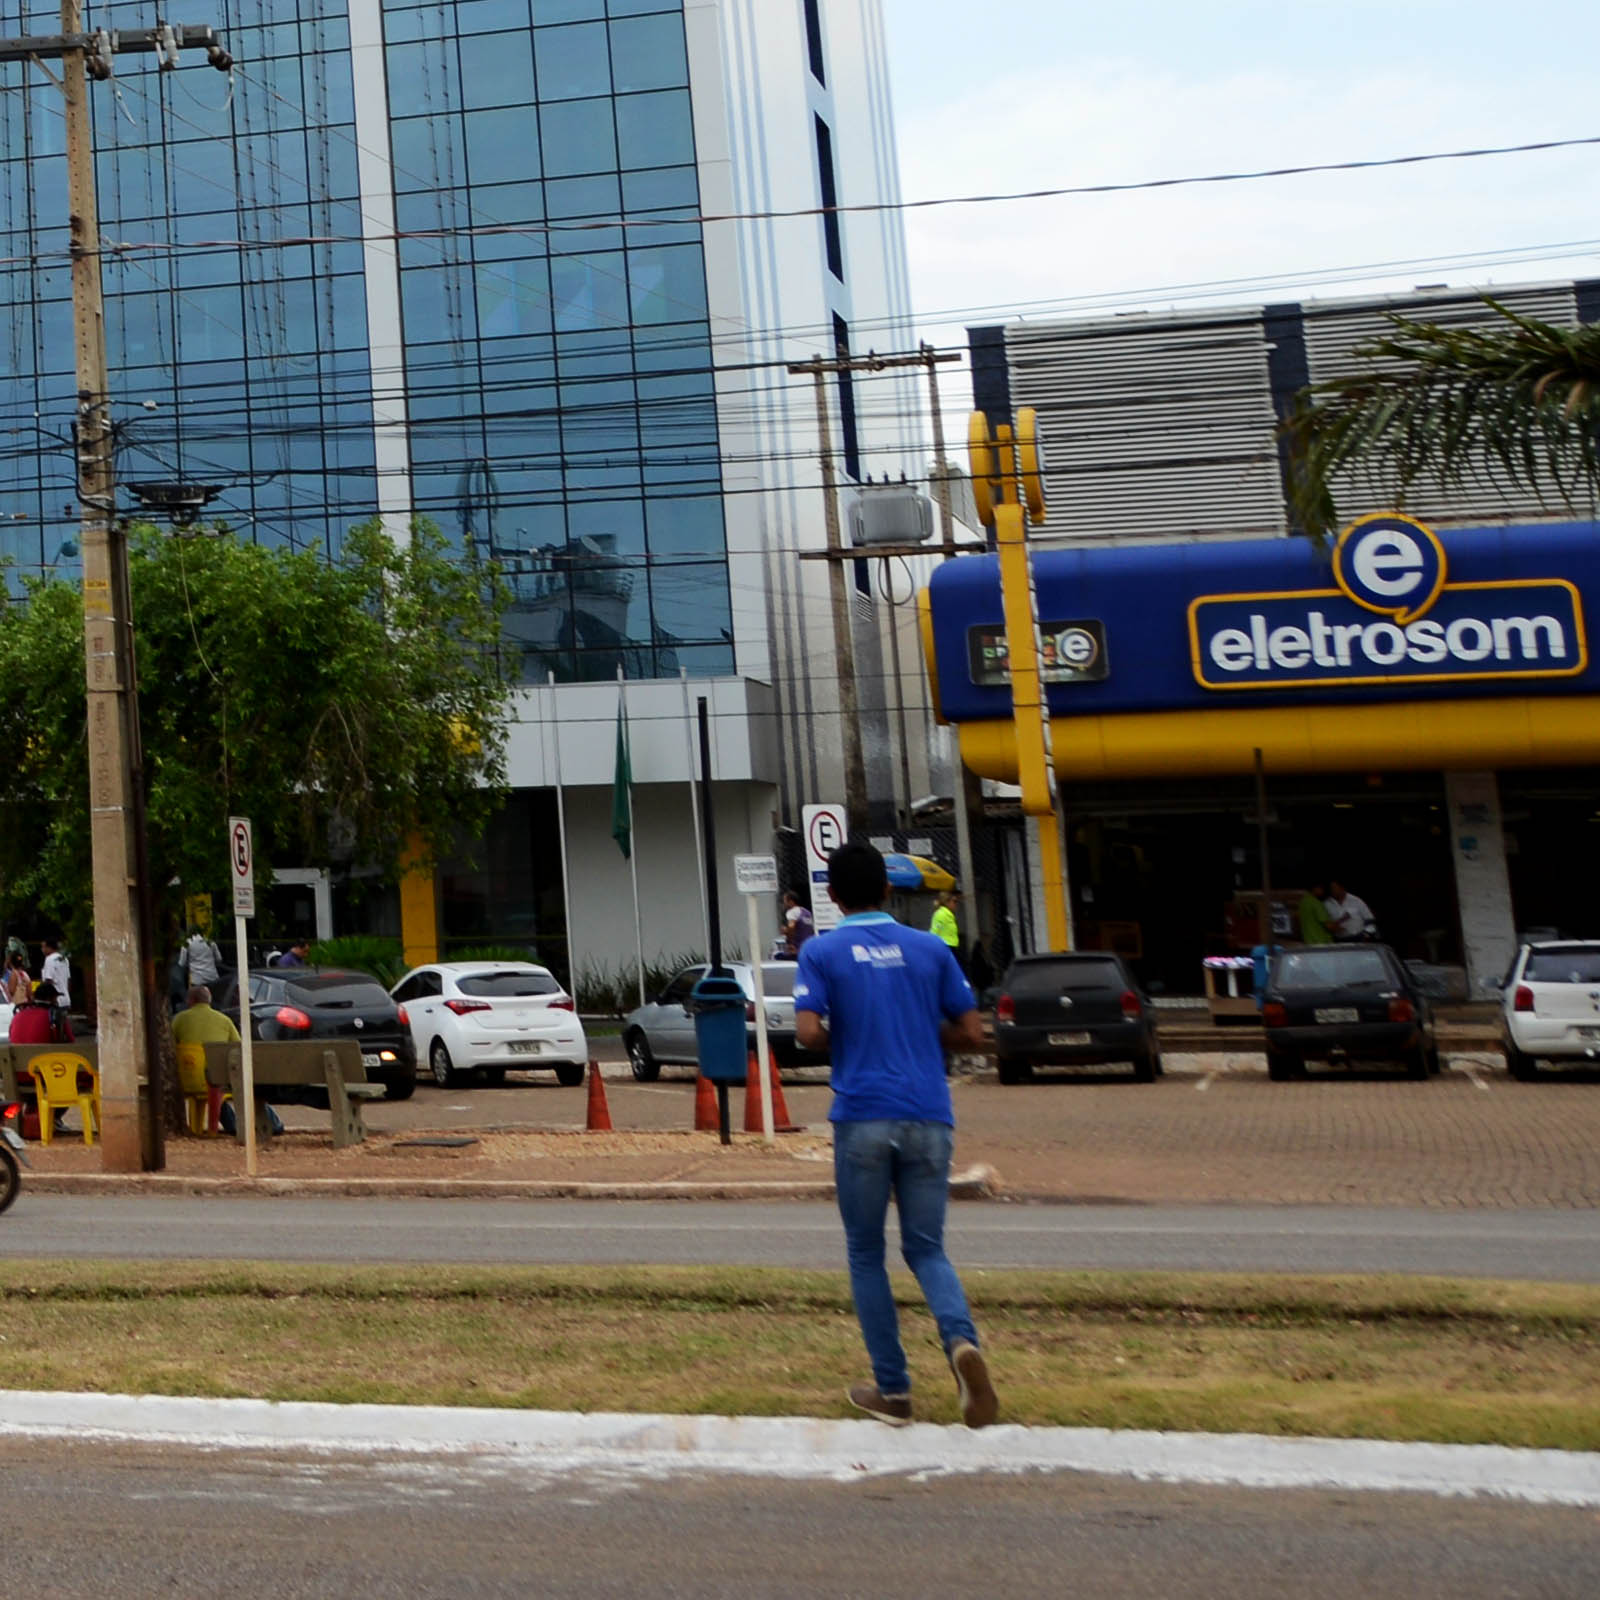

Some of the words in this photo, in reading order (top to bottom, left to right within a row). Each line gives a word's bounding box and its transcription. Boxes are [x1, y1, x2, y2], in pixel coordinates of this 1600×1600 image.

[1352, 529, 1424, 597] e
[1209, 611, 1567, 672] eletrosom
[819, 821, 833, 852] E
